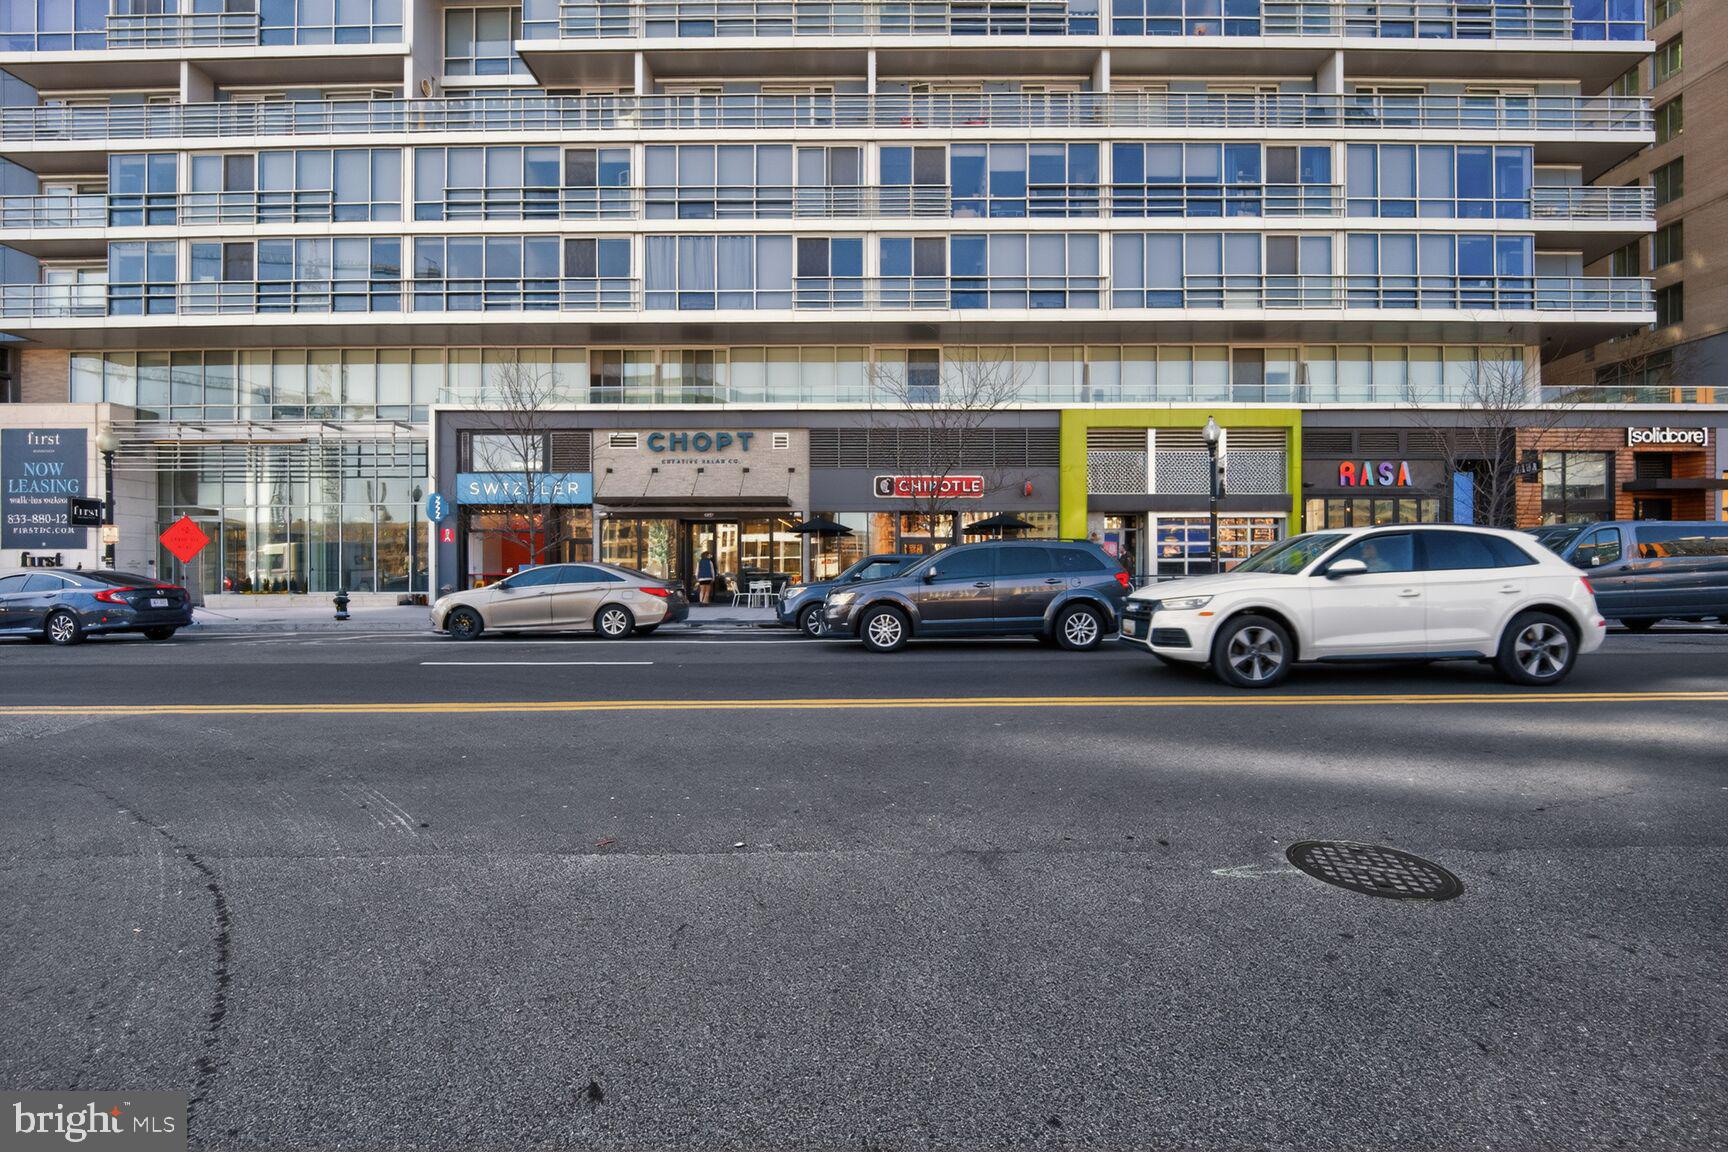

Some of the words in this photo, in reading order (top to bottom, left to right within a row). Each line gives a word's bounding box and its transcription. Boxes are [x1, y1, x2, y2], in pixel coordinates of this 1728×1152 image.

[27, 431, 60, 445] first
[647, 431, 754, 452] CHOPT
[1627, 427, 1708, 446] [solidcore]
[23, 462, 64, 476] NOW
[1339, 460, 1413, 487] RASA
[8, 479, 79, 493] LEASING
[469, 481, 579, 495] SWIZLER
[898, 480, 980, 492] CHIPOTLE
[73, 504, 99, 517] first
[7, 513, 68, 524] 833-880-12
[20, 551, 63, 567] first
